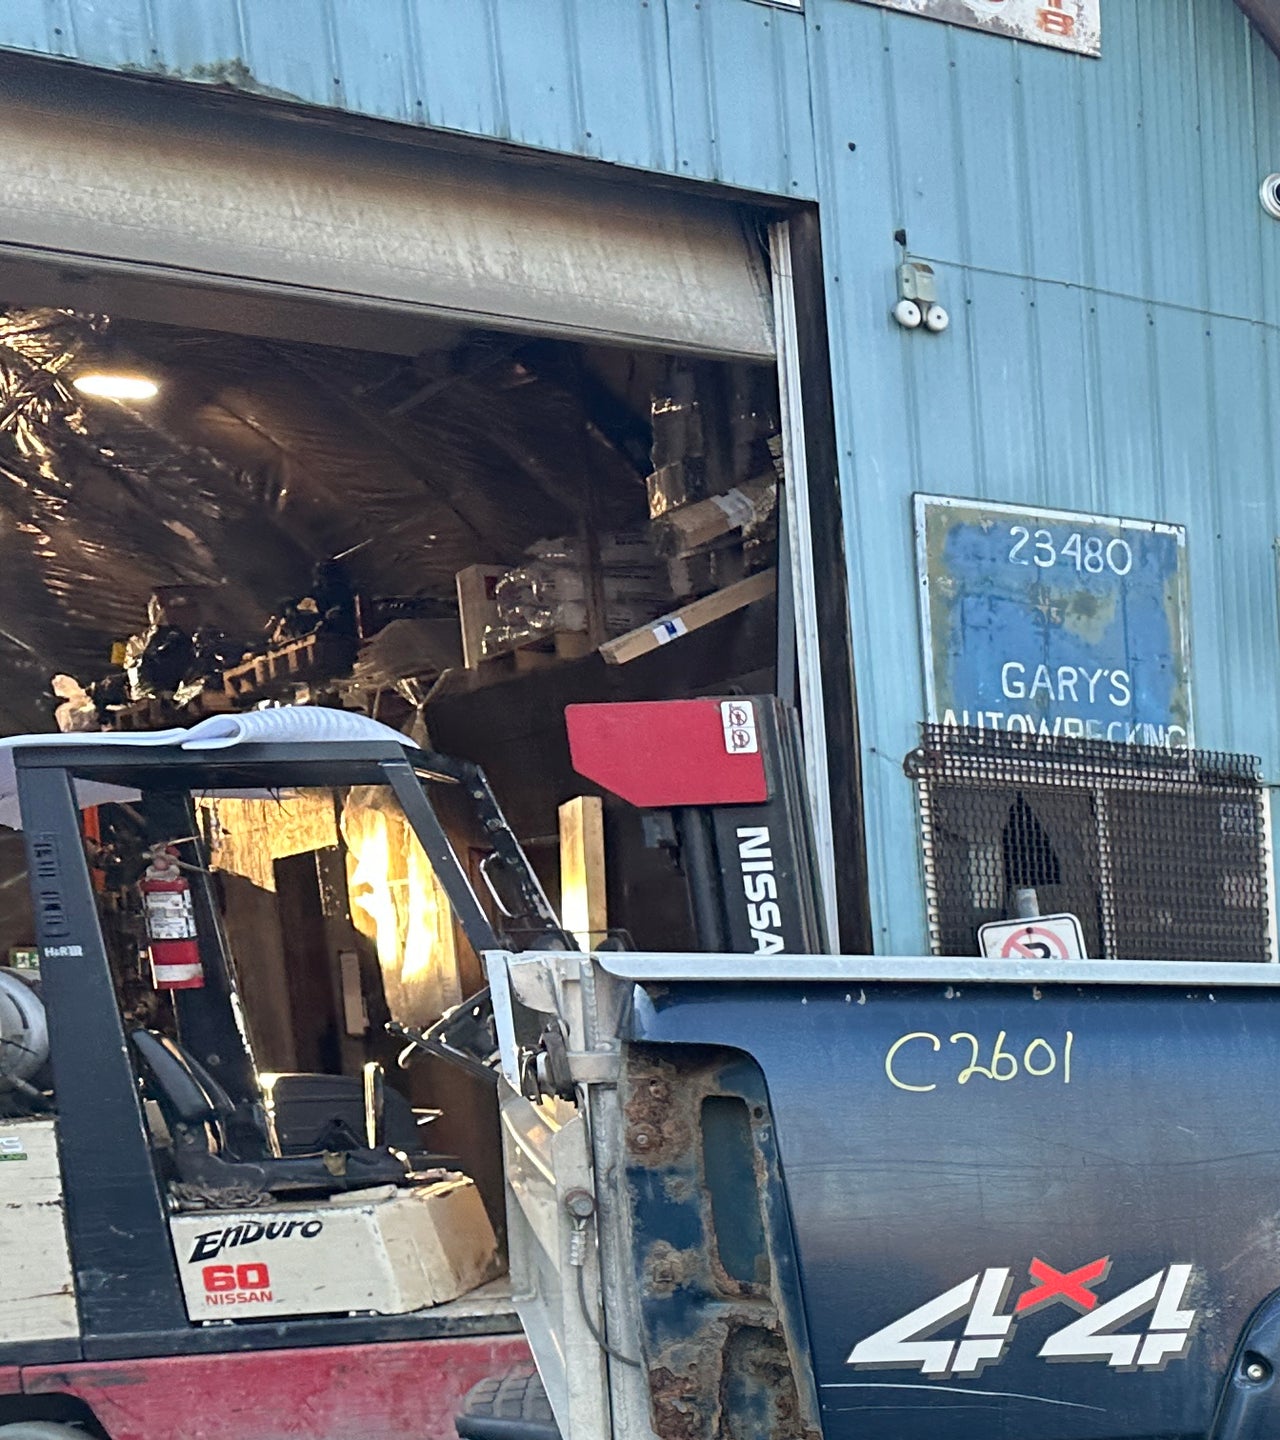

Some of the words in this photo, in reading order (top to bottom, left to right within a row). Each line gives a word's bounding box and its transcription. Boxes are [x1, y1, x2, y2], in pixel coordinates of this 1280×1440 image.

[1008, 526, 1133, 576] 23480
[1001, 662, 1131, 707] GARY'S
[885, 1031, 1074, 1091] C2601
[202, 1262, 270, 1293] 60
[205, 1291, 274, 1306] NISSAN
